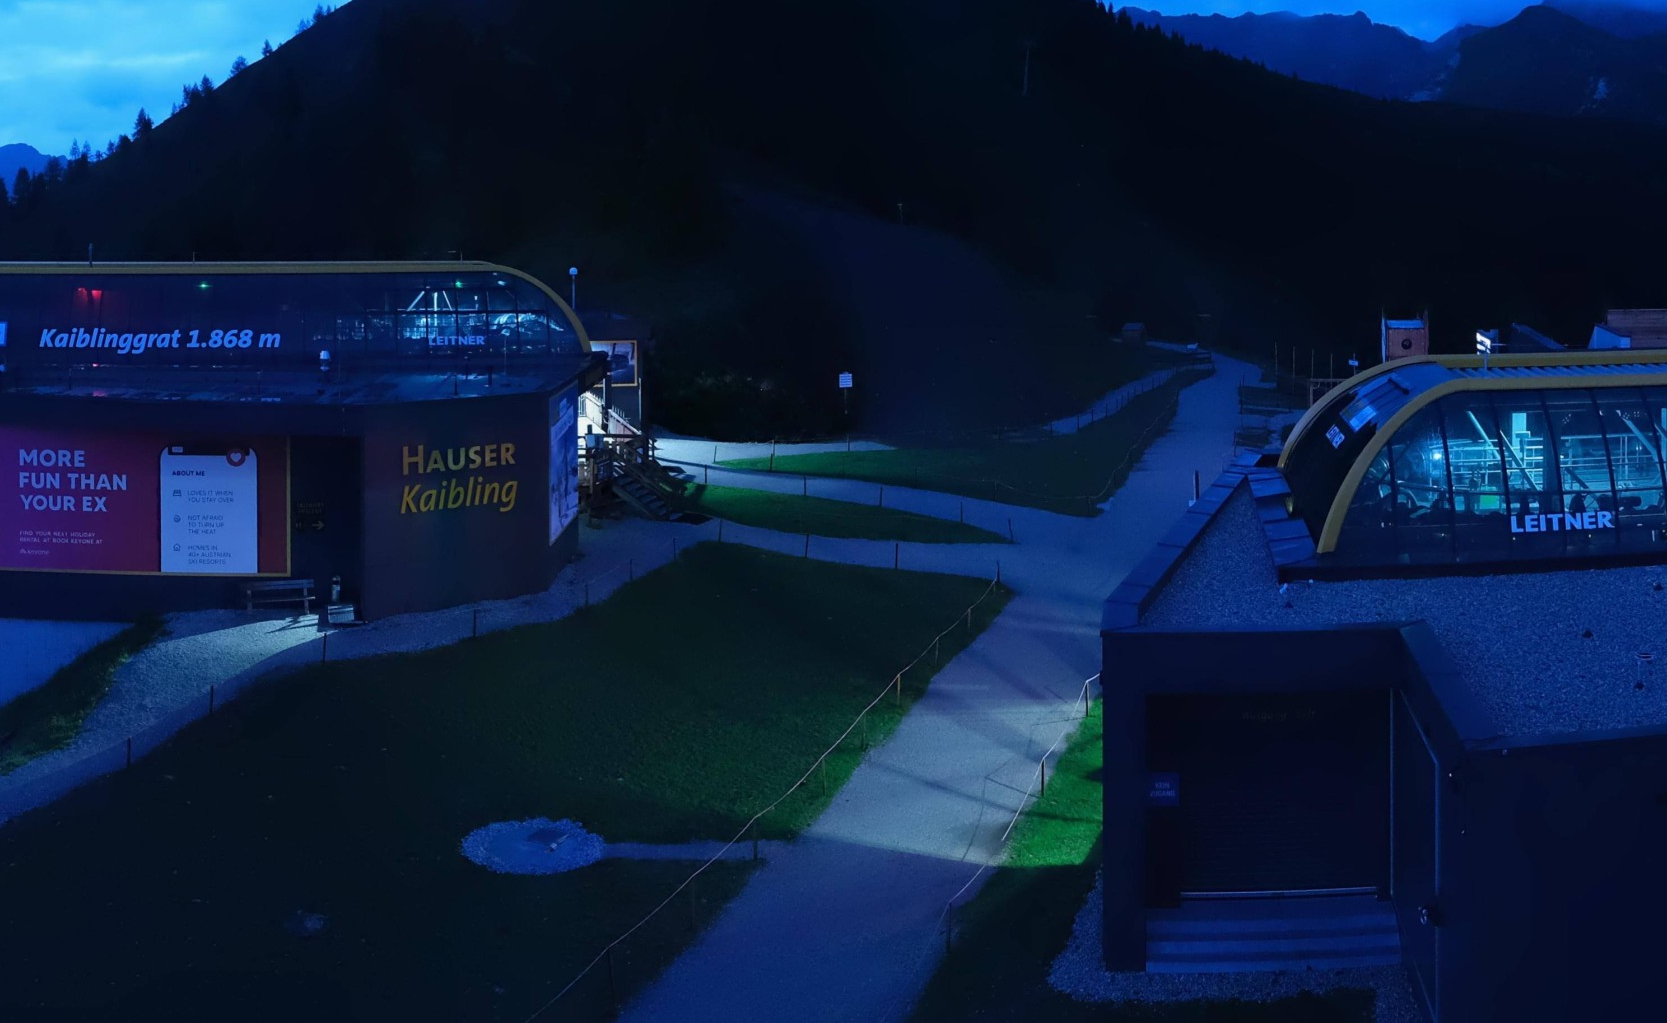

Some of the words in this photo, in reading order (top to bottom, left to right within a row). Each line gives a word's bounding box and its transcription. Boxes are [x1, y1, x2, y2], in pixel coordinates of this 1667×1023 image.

[39, 328, 181, 354] Kaiblinggrat
[186, 329, 252, 348] 1.868
[258, 333, 281, 348] m
[428, 335, 486, 346] LEITNER
[19, 449, 85, 467] MORE
[402, 443, 517, 475] HAUSER
[19, 472, 60, 489] FUN
[67, 473, 127, 490] THAN
[20, 494, 75, 511] YOUR
[82, 496, 107, 512] EX
[401, 477, 518, 514] Kaibling
[1510, 510, 1616, 534] LEITNER
